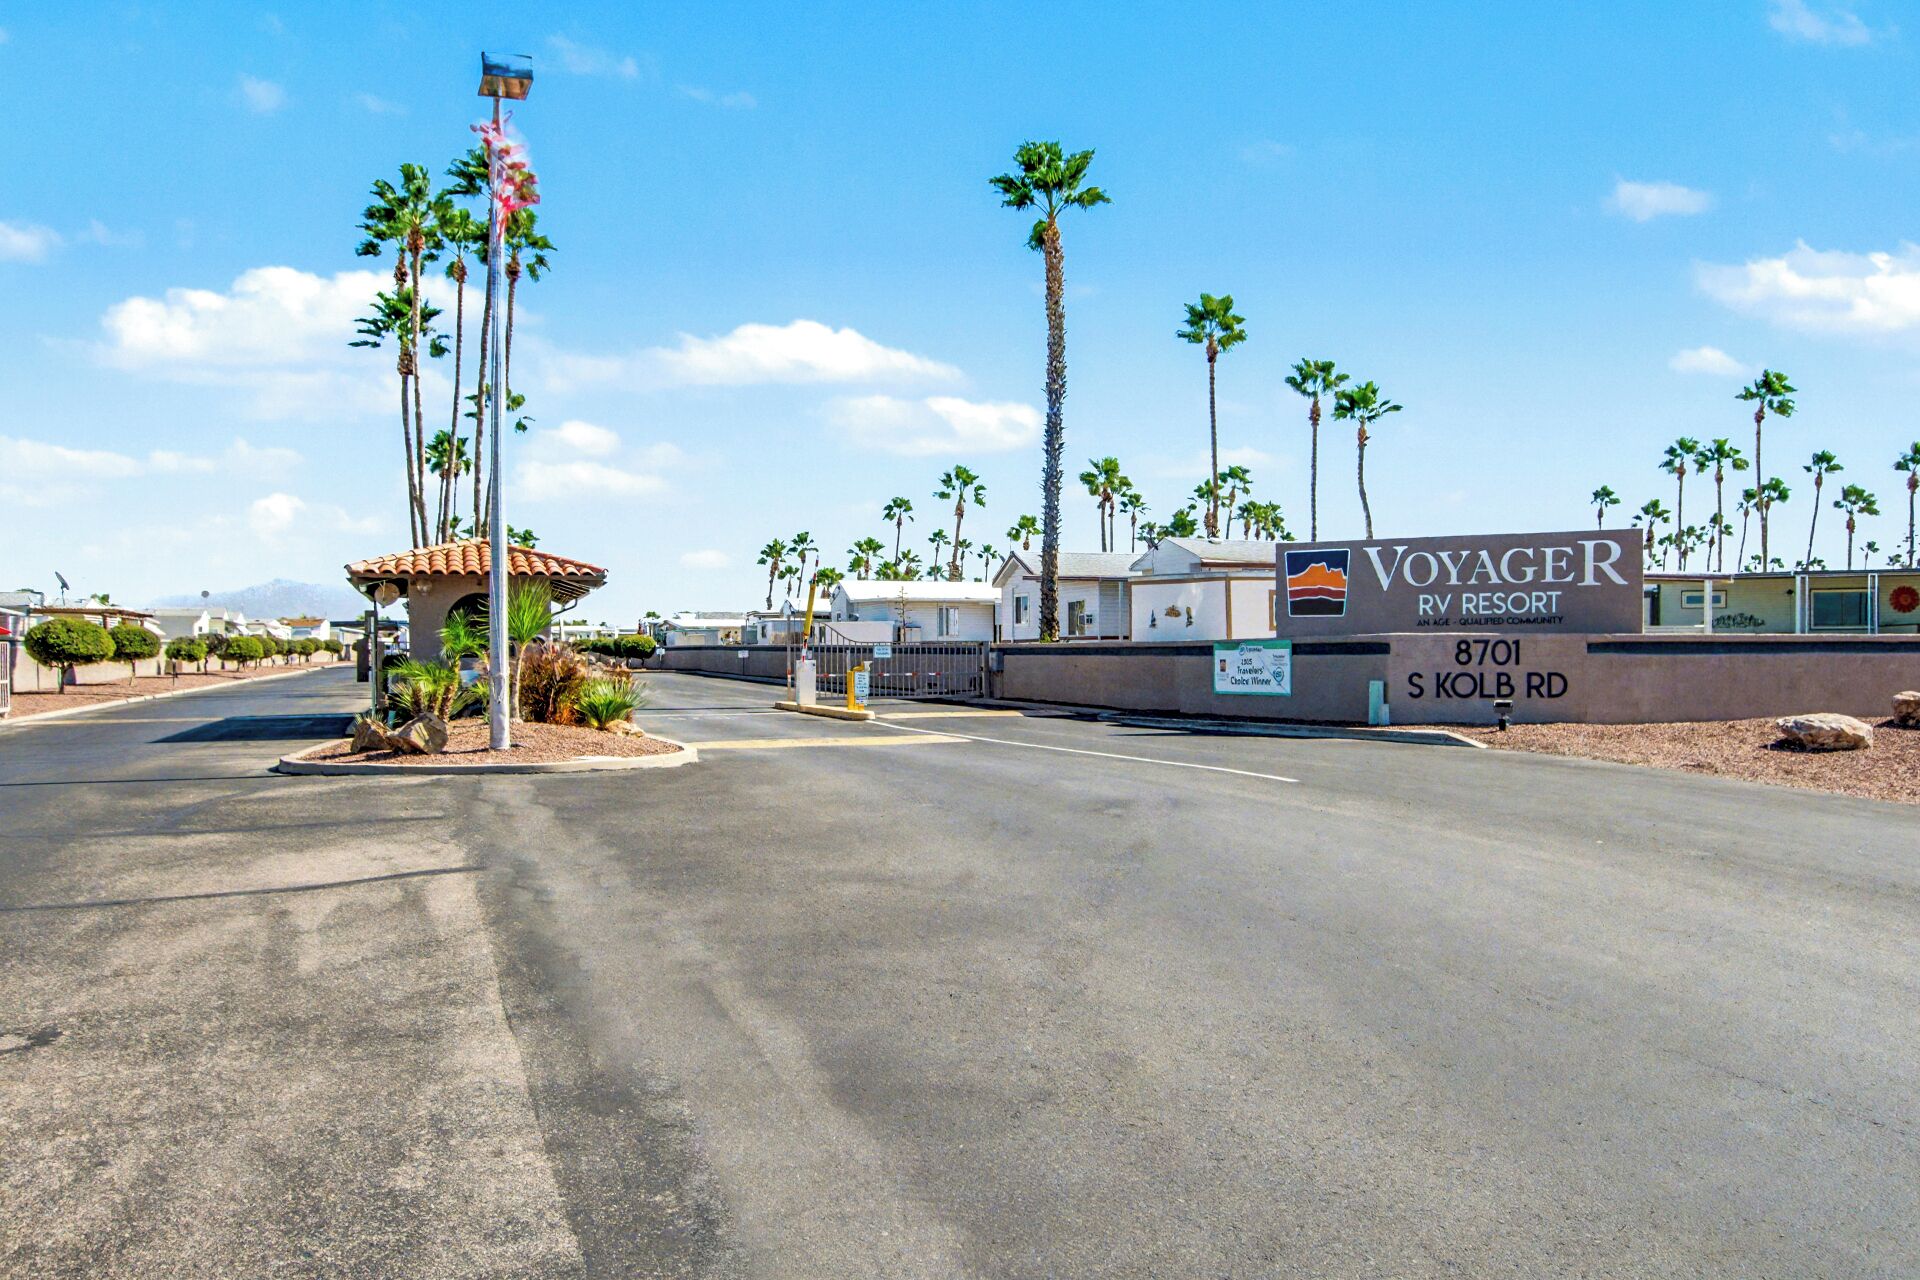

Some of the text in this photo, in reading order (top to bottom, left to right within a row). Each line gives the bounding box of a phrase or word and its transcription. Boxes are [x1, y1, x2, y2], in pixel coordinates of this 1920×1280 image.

[1363, 540, 1628, 592] VOYAGER
[1419, 591, 1562, 615] RV RESORT
[1416, 619, 1430, 627] AN
[1433, 618, 1450, 626] AGE
[1459, 617, 1504, 626] QUALIFIED
[1506, 616, 1564, 625] COMMUNITY
[1455, 639, 1520, 666] 8701
[1230, 676, 1249, 685] Choice
[1408, 672, 1568, 699] S KOLB RD
